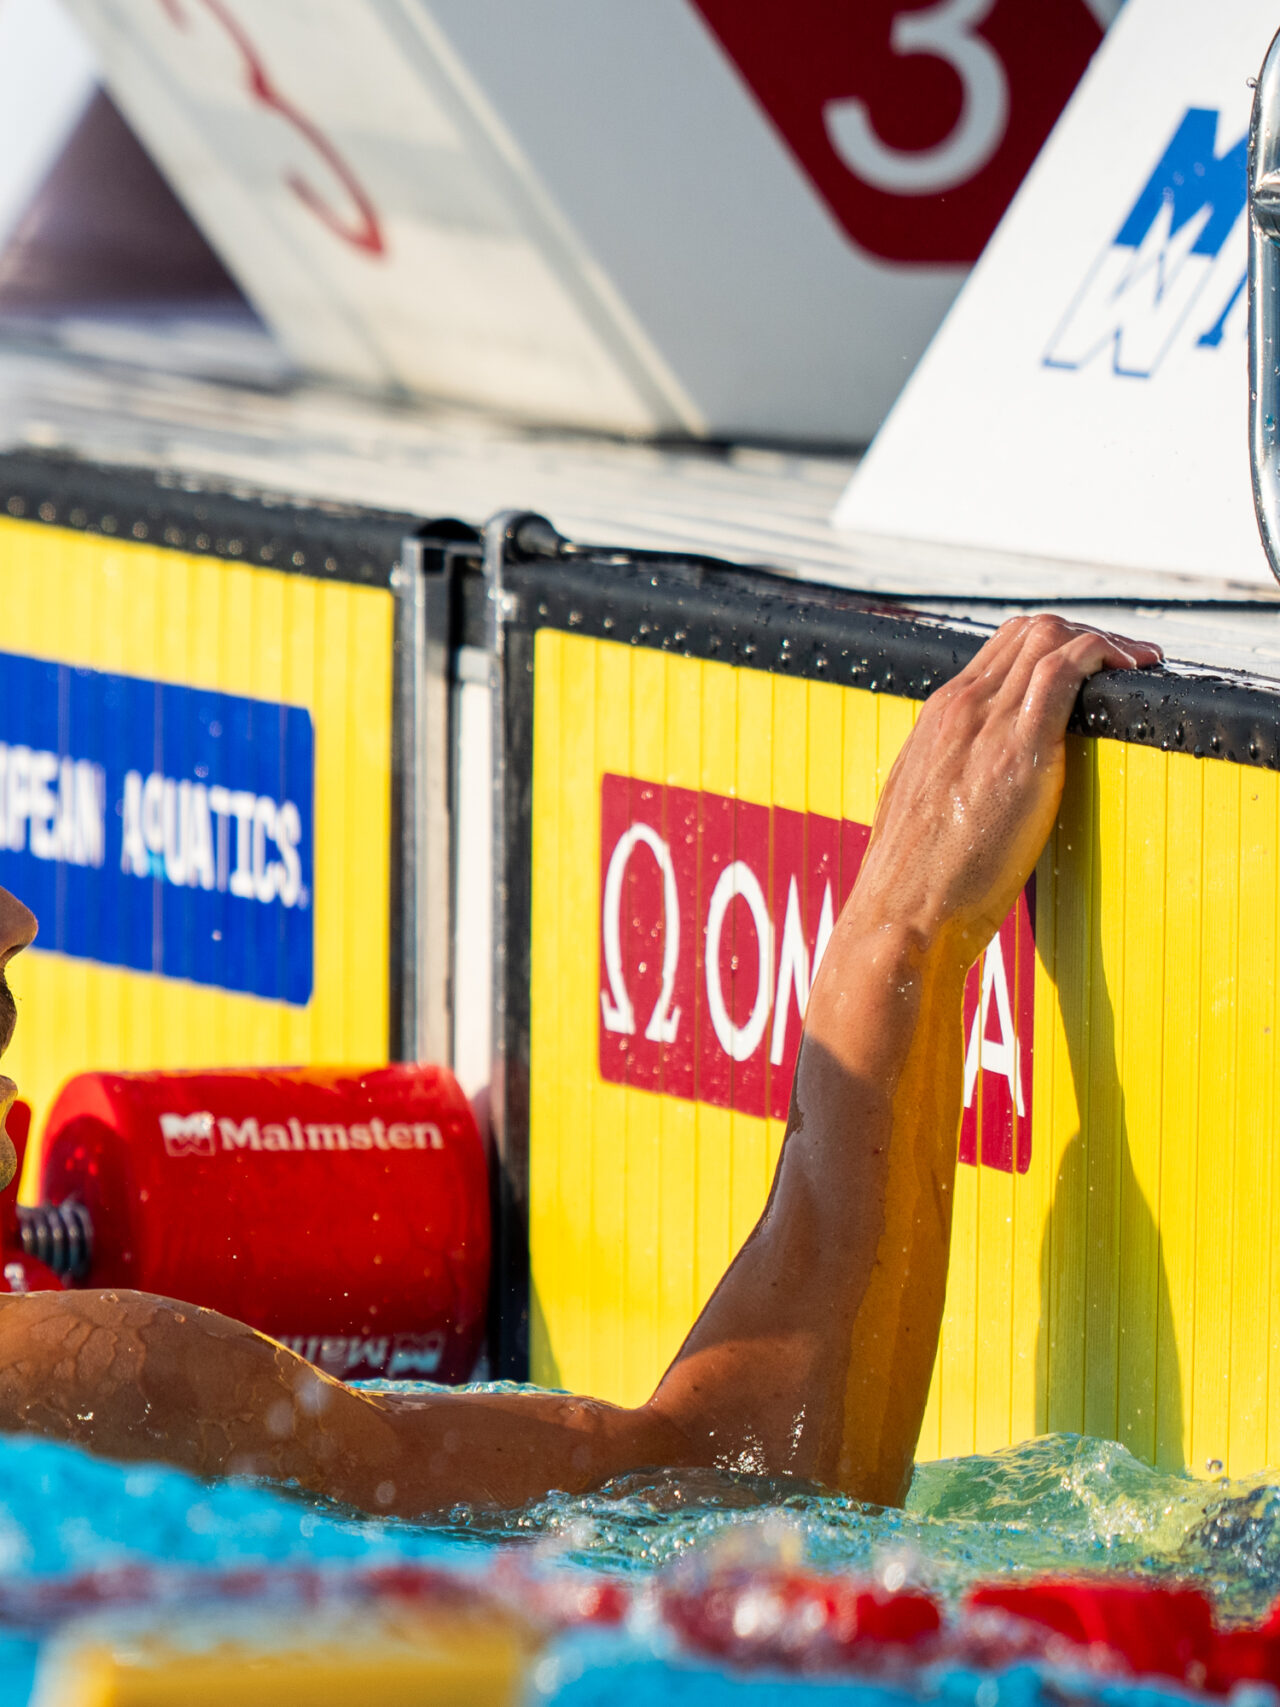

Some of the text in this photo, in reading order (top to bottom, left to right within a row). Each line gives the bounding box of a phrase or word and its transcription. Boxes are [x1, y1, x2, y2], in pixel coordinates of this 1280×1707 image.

[822, 0, 1010, 196] 3
[704, 859, 1026, 1118] OMA
[218, 1116, 444, 1151] Malmsten
